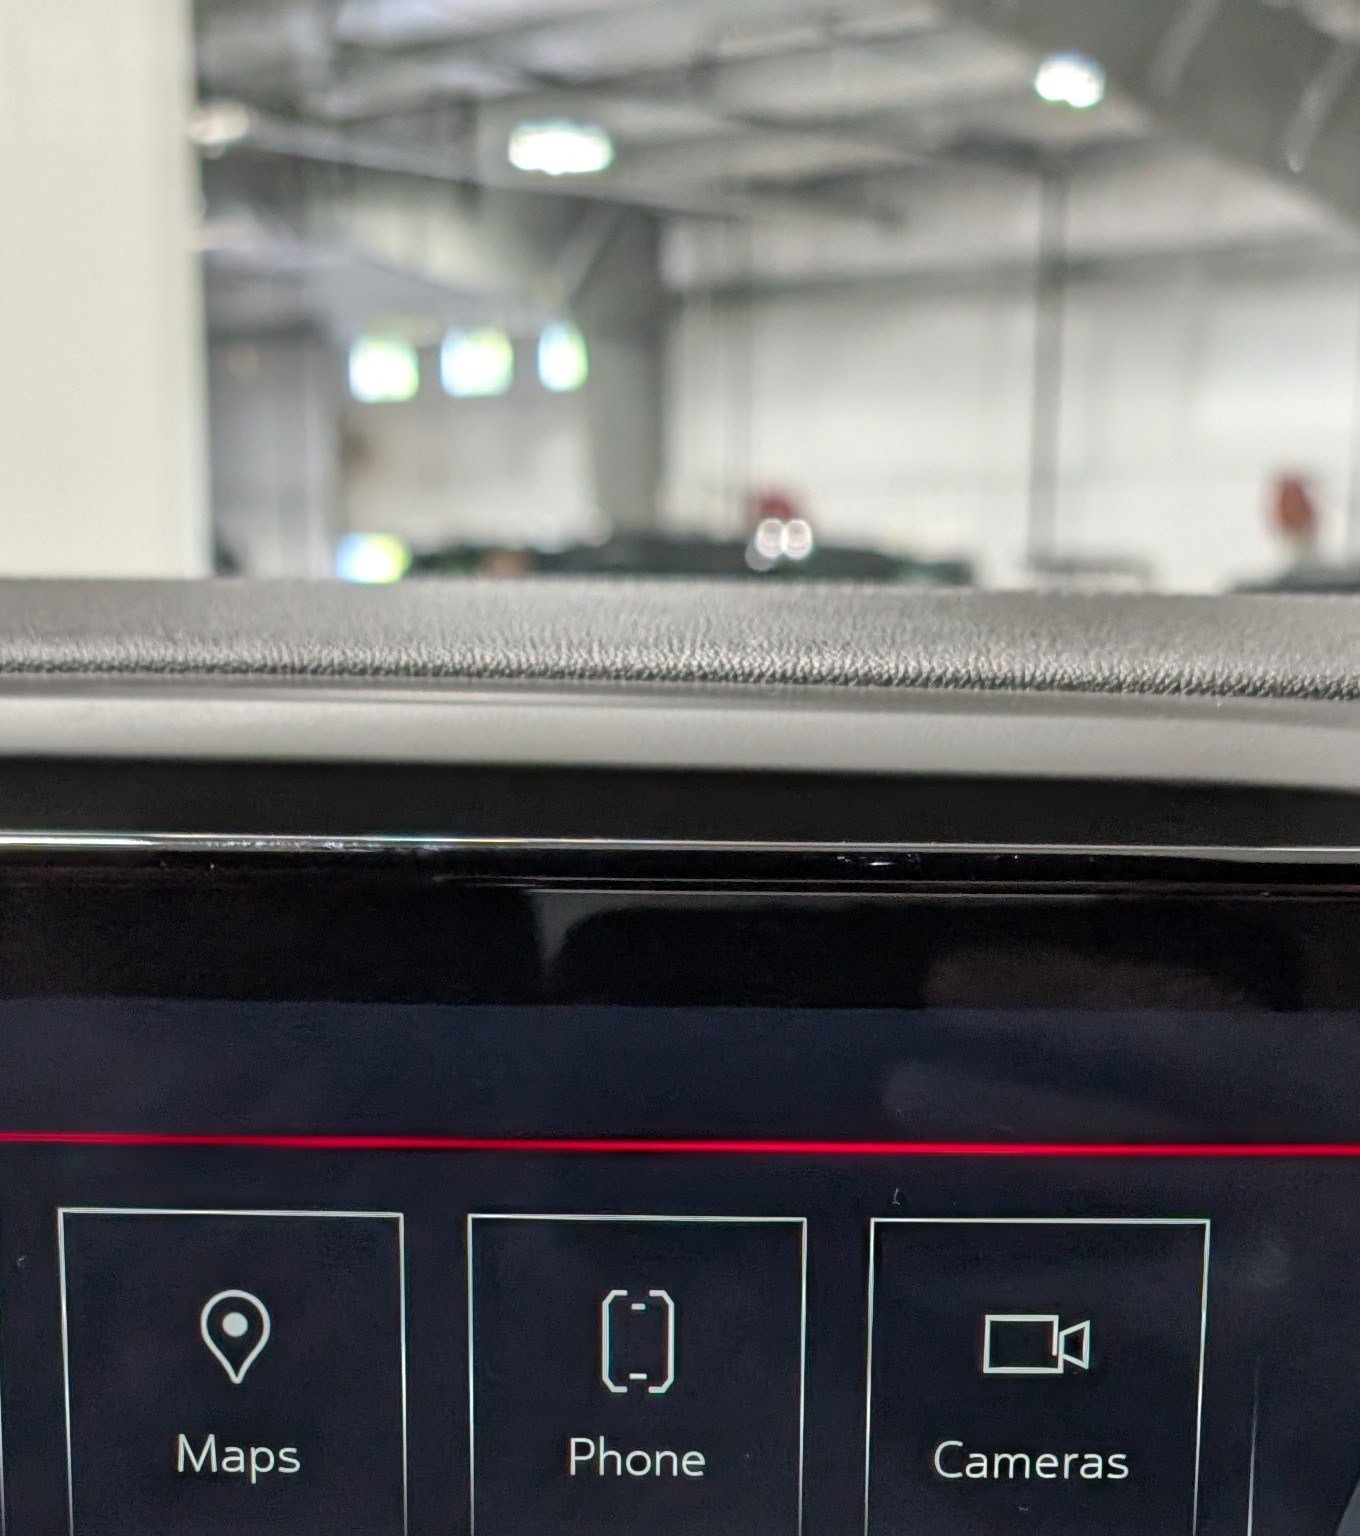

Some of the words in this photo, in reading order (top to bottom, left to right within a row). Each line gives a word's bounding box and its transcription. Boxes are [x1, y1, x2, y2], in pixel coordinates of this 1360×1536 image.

[177, 1433, 301, 1483] Maps
[570, 1435, 706, 1477] Phone
[934, 1440, 1129, 1480] Cameras
